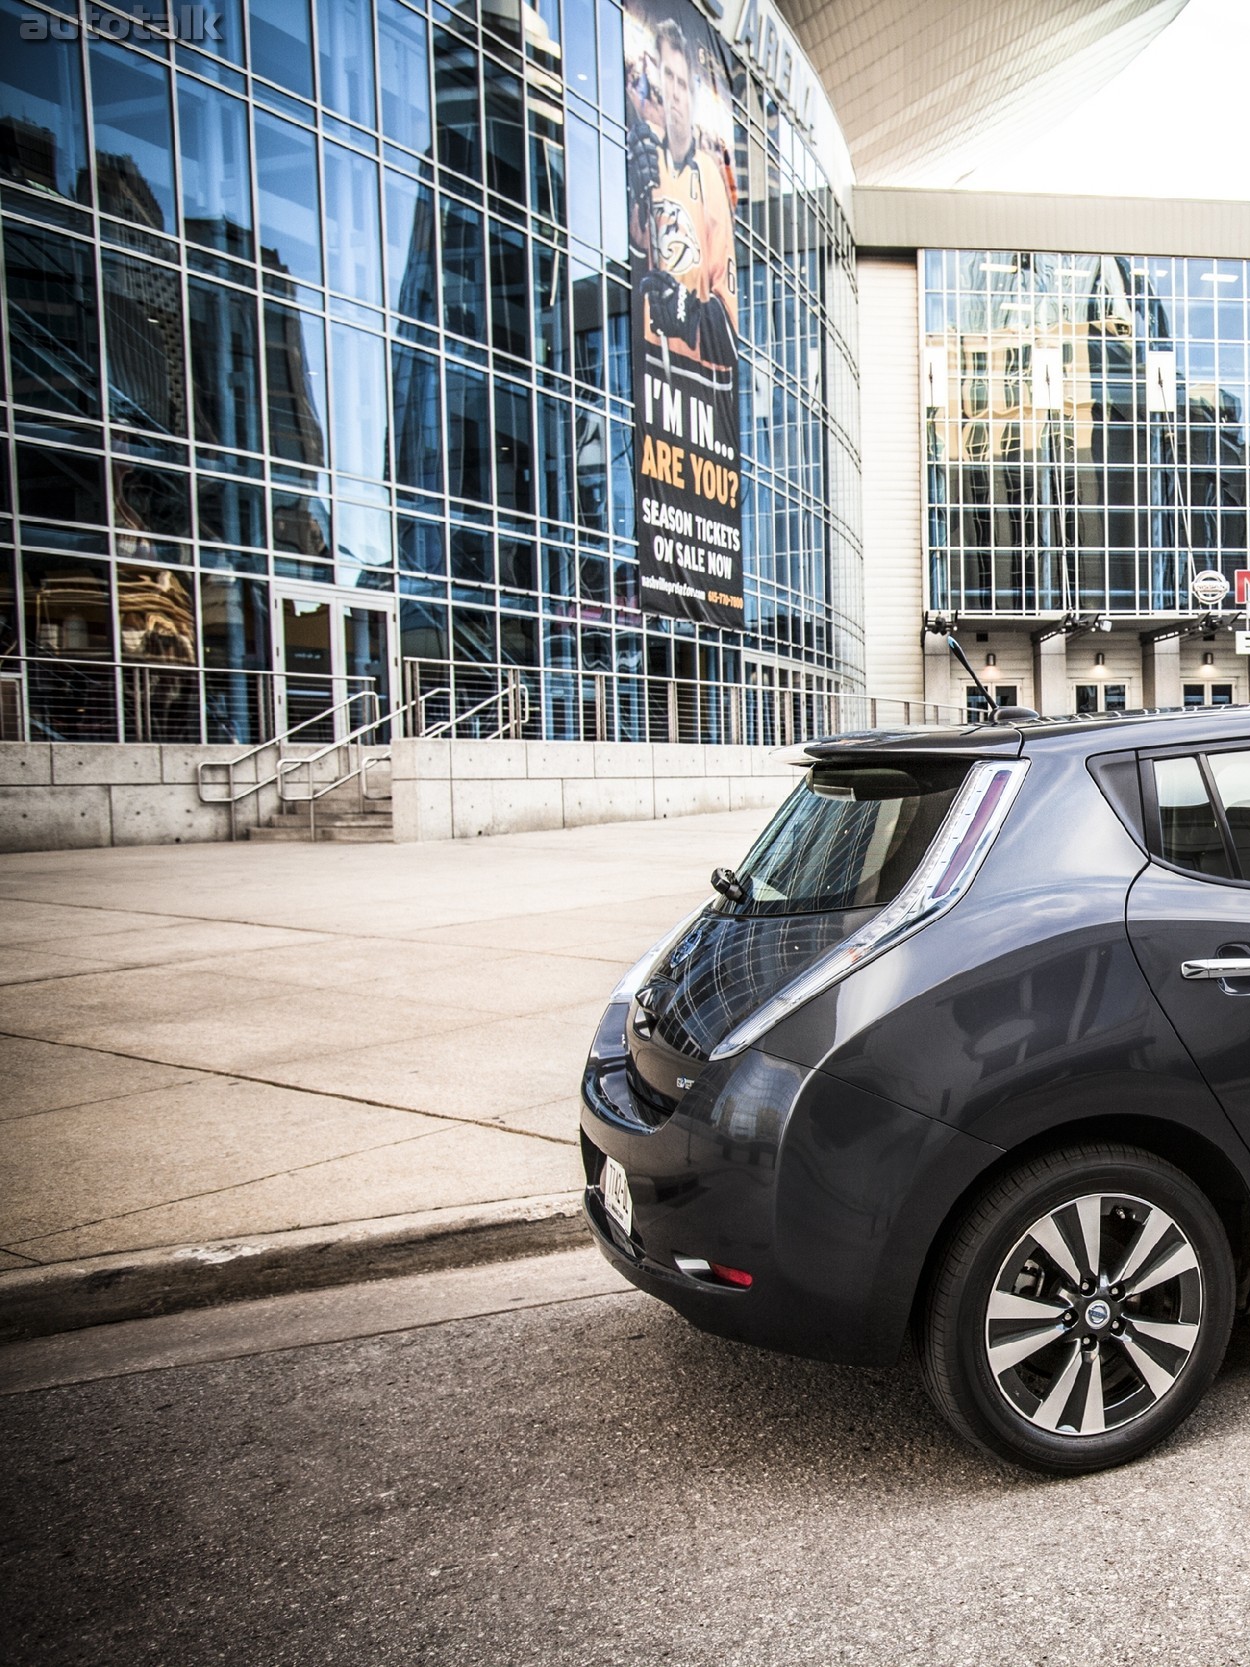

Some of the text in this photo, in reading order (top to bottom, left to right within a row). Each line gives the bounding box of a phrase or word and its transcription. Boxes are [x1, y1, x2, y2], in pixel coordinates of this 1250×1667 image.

[735, 0, 817, 145] ARENA
[644, 373, 683, 438] I'M
[641, 434, 739, 509] ARE YOU?
[642, 497, 740, 552] SEASON TICKETS
[675, 542, 706, 573] SALE
[707, 551, 733, 580] NOW
